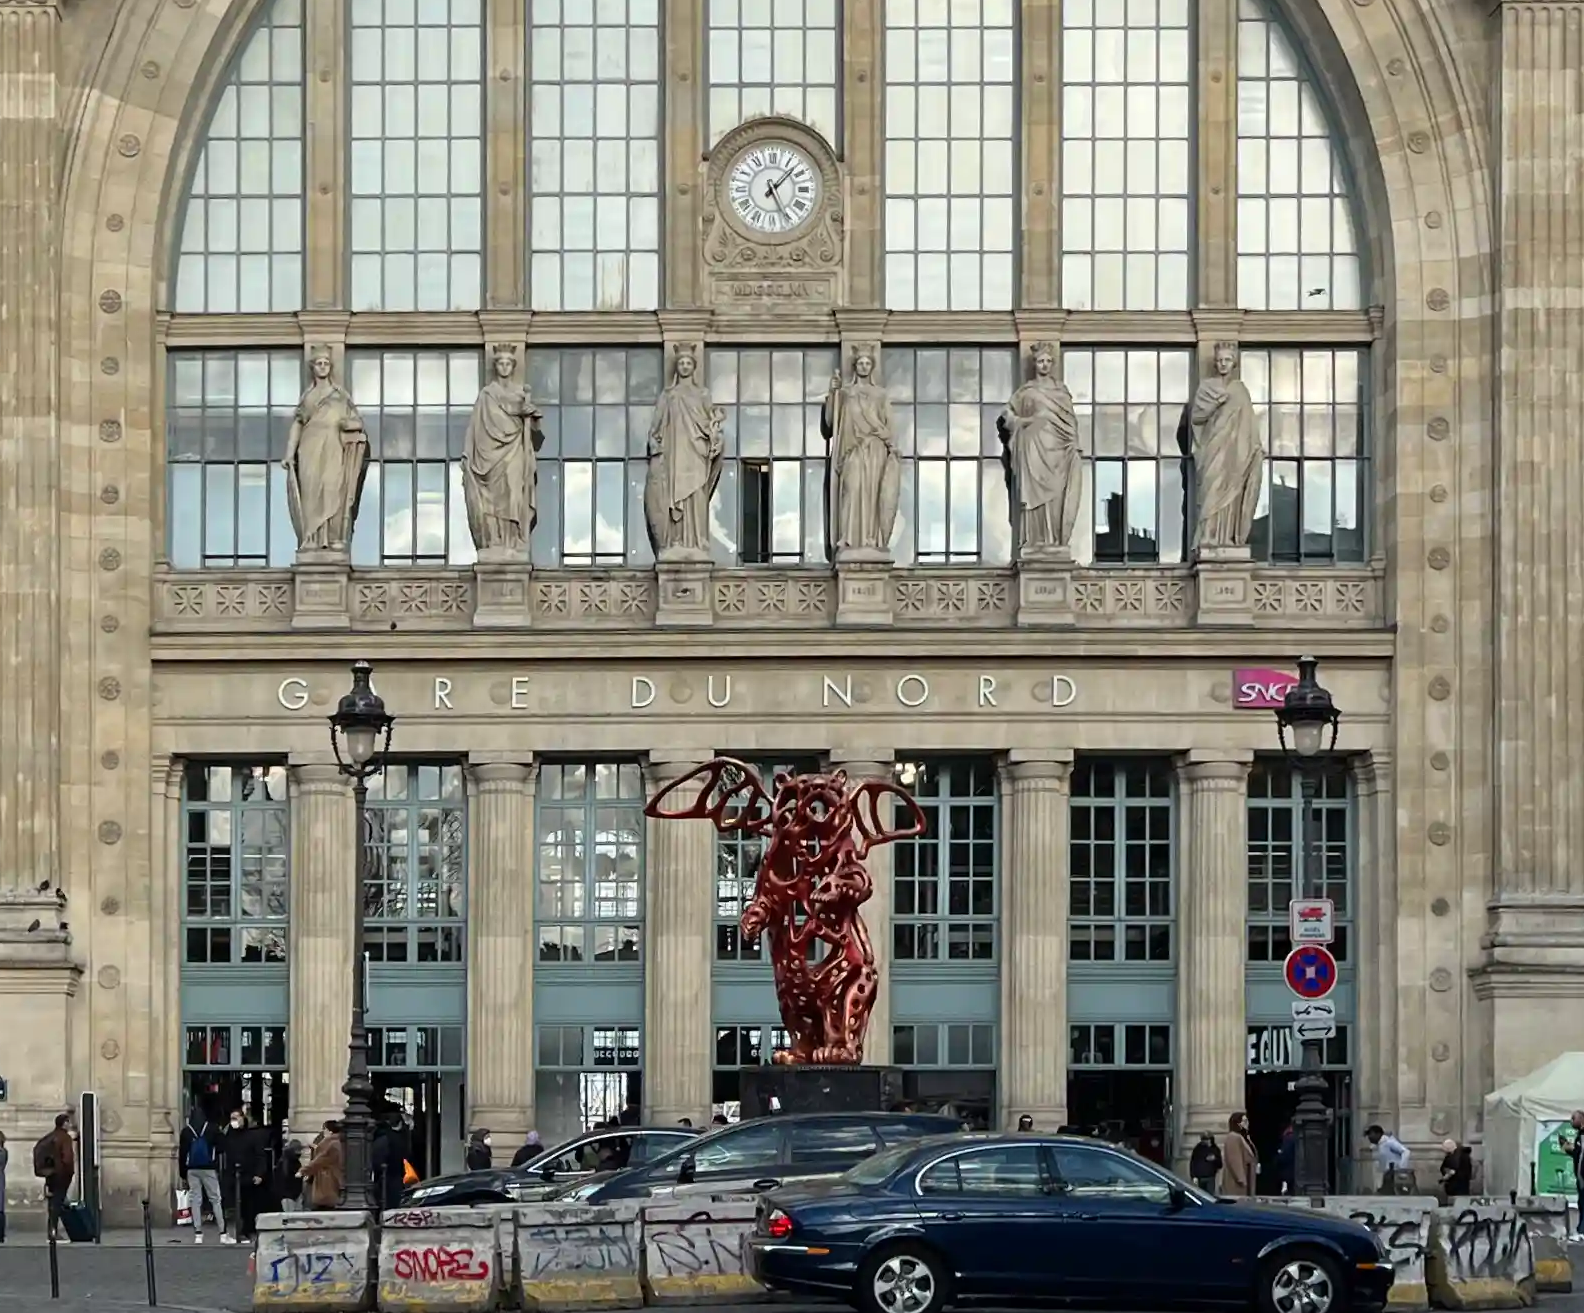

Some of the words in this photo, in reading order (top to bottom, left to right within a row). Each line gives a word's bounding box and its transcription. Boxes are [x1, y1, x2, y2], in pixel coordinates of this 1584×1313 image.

[278, 676, 529, 710] GRE
[631, 675, 732, 709] DU
[822, 674, 1077, 707] NORD
